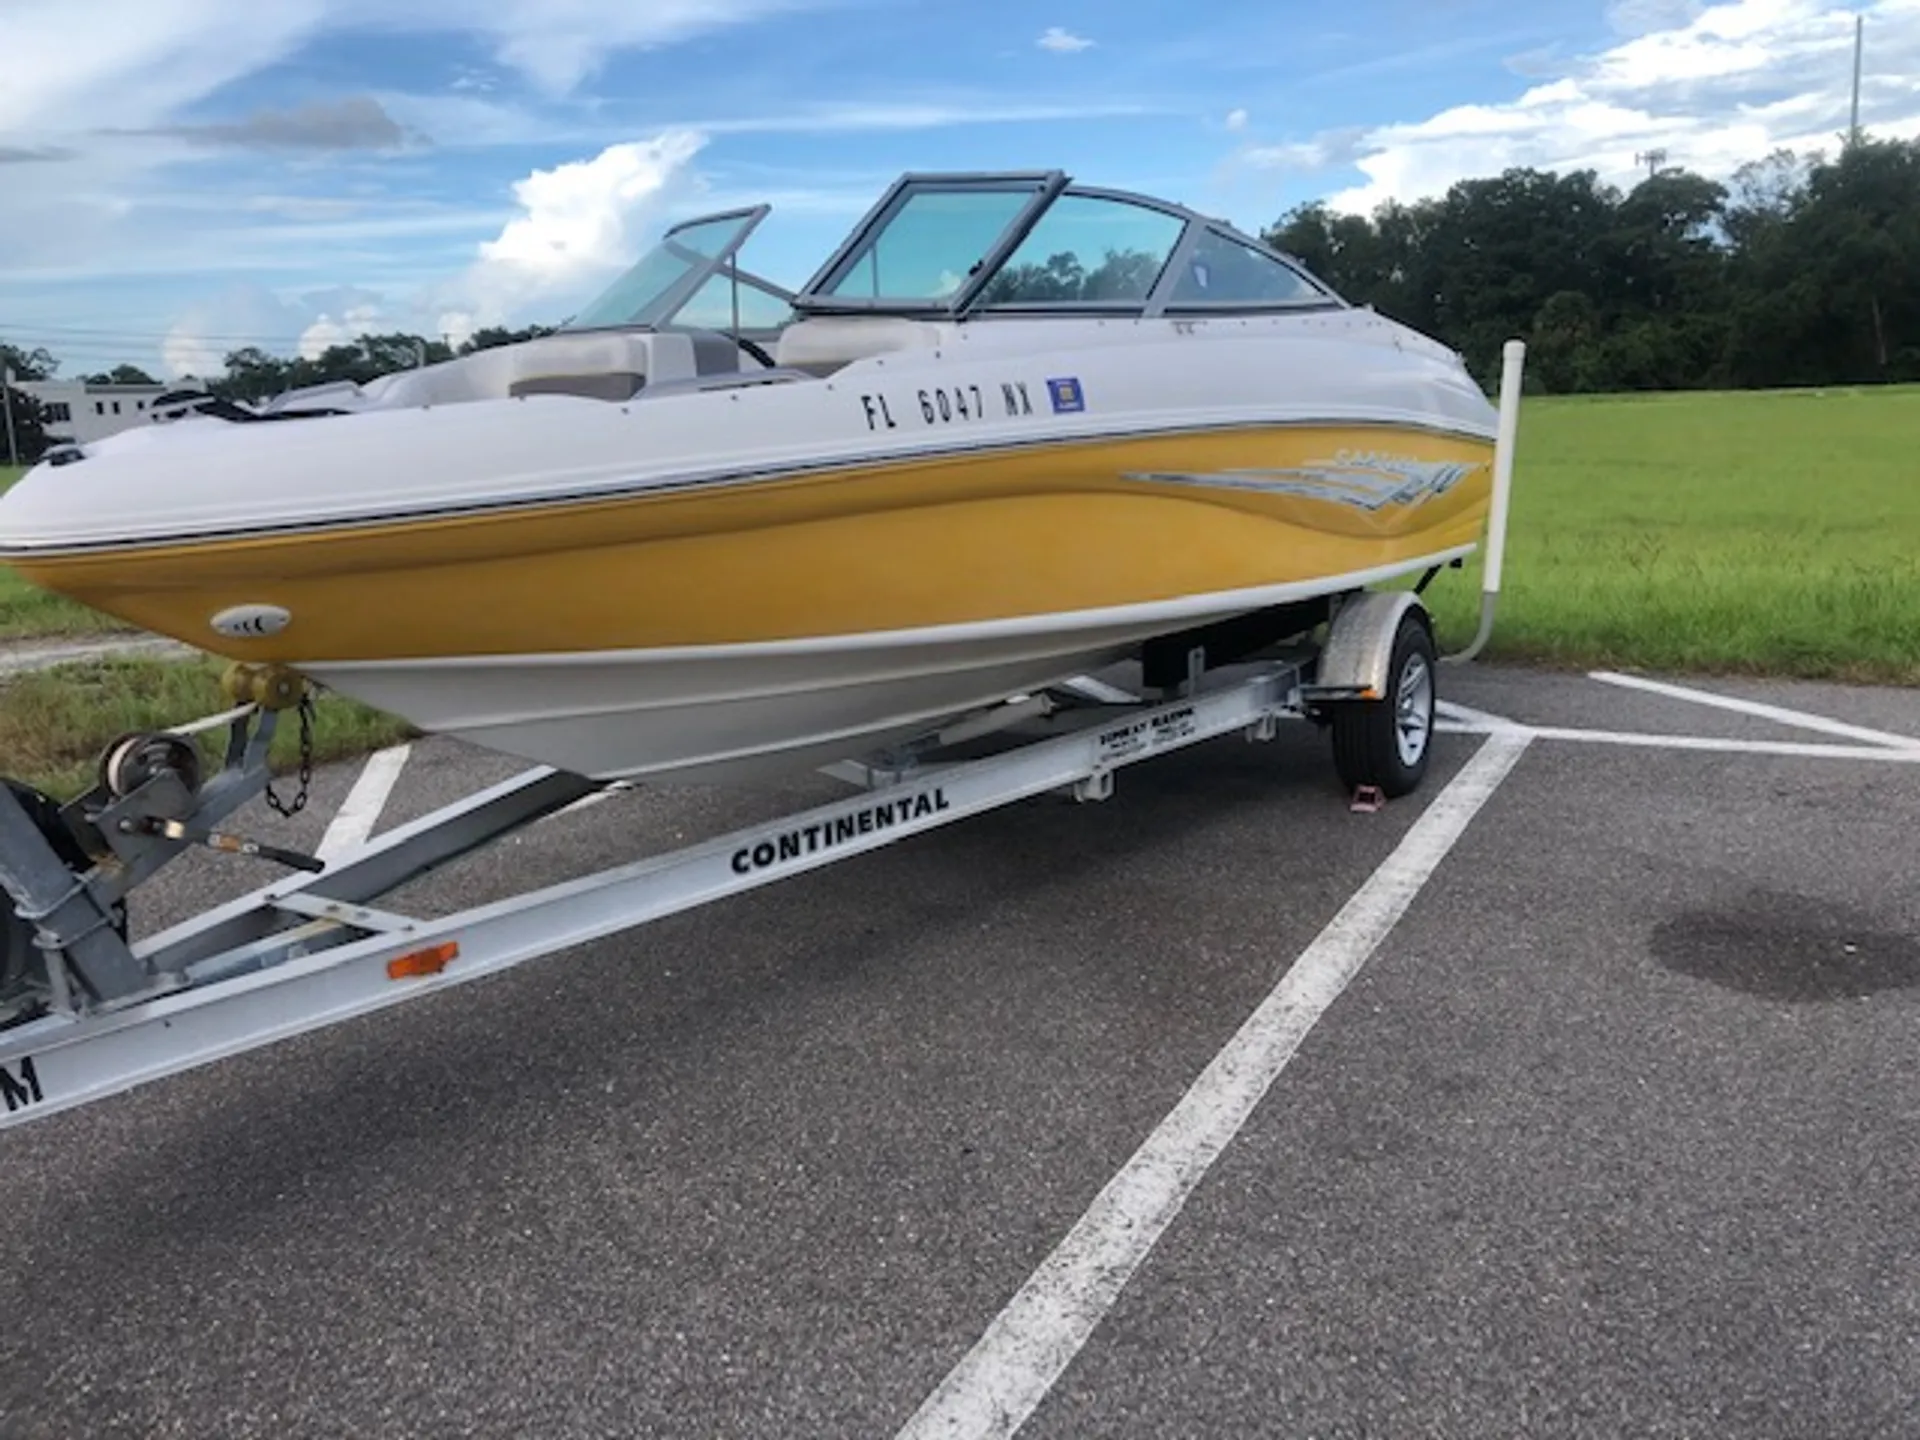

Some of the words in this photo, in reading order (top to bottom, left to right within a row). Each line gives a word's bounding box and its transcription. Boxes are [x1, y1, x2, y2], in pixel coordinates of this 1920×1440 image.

[861, 394, 896, 430] FL
[917, 385, 983, 424] 6047
[731, 787, 950, 874] CONTINENTAL
